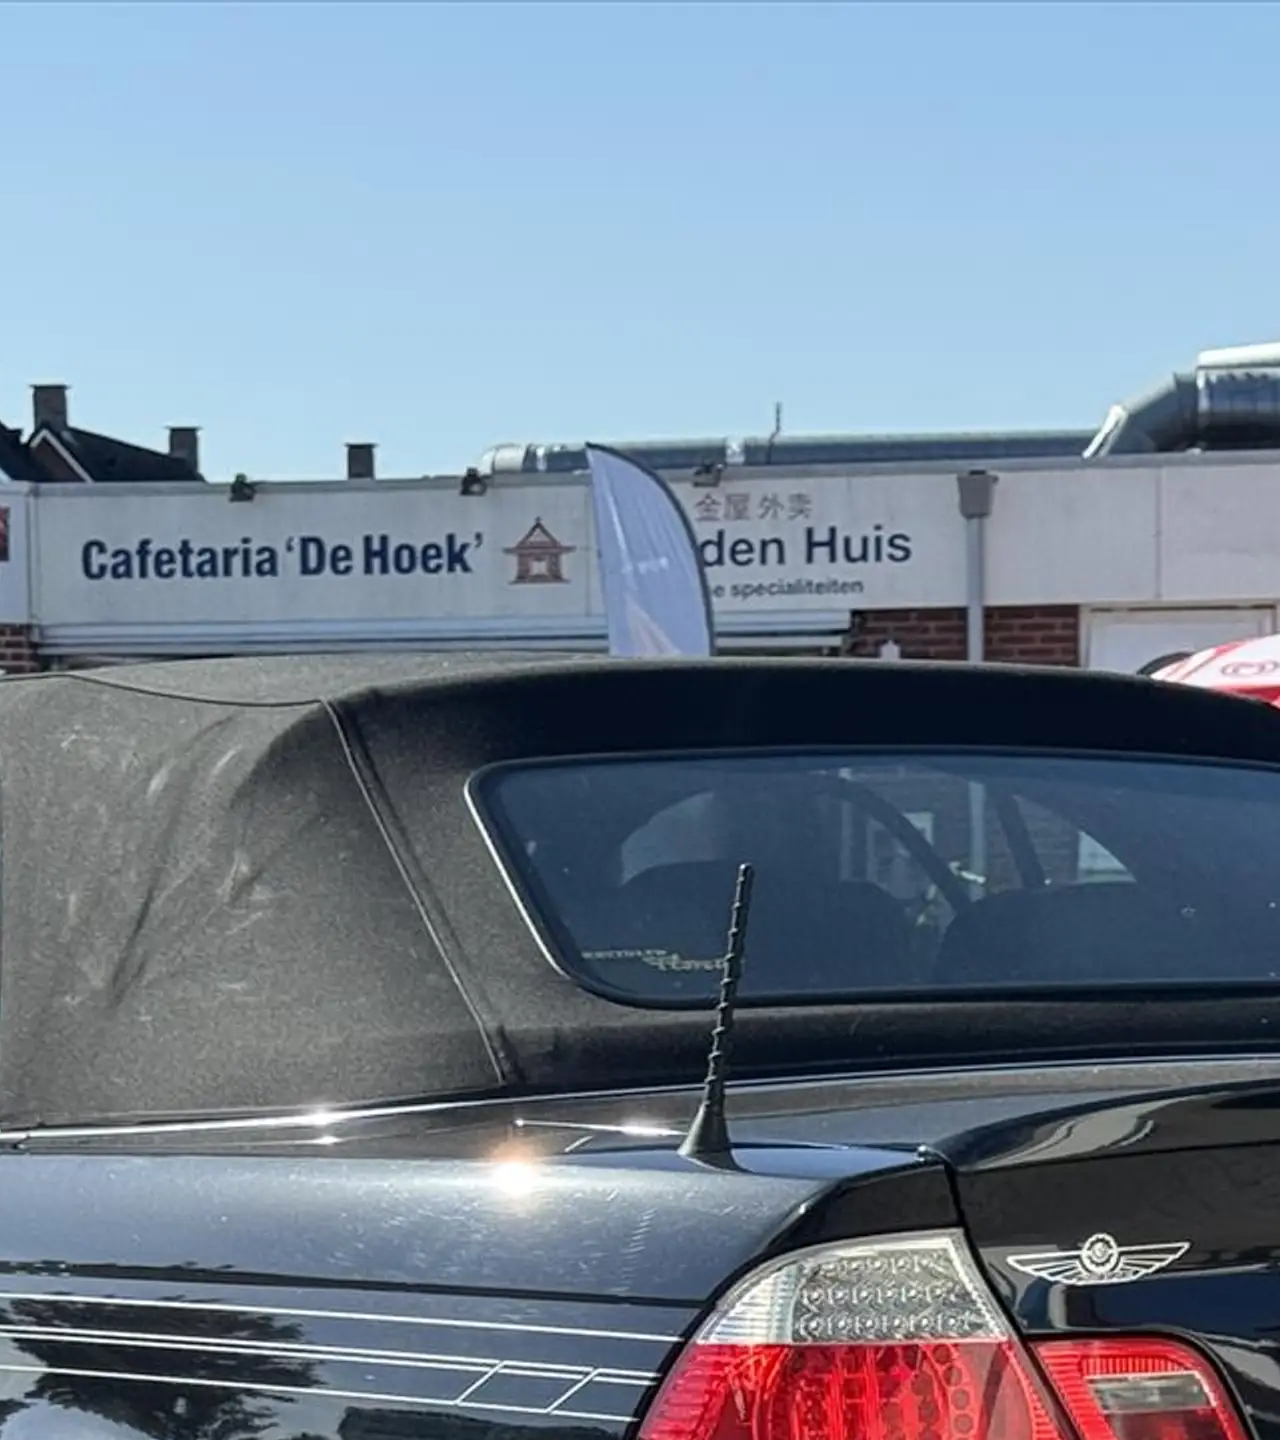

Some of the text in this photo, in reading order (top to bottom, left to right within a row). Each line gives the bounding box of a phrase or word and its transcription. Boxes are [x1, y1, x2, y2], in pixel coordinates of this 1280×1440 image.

[81, 537, 279, 580] Cafetaria
[805, 524, 913, 564] Huis
[730, 577, 865, 599] specialiteiten
